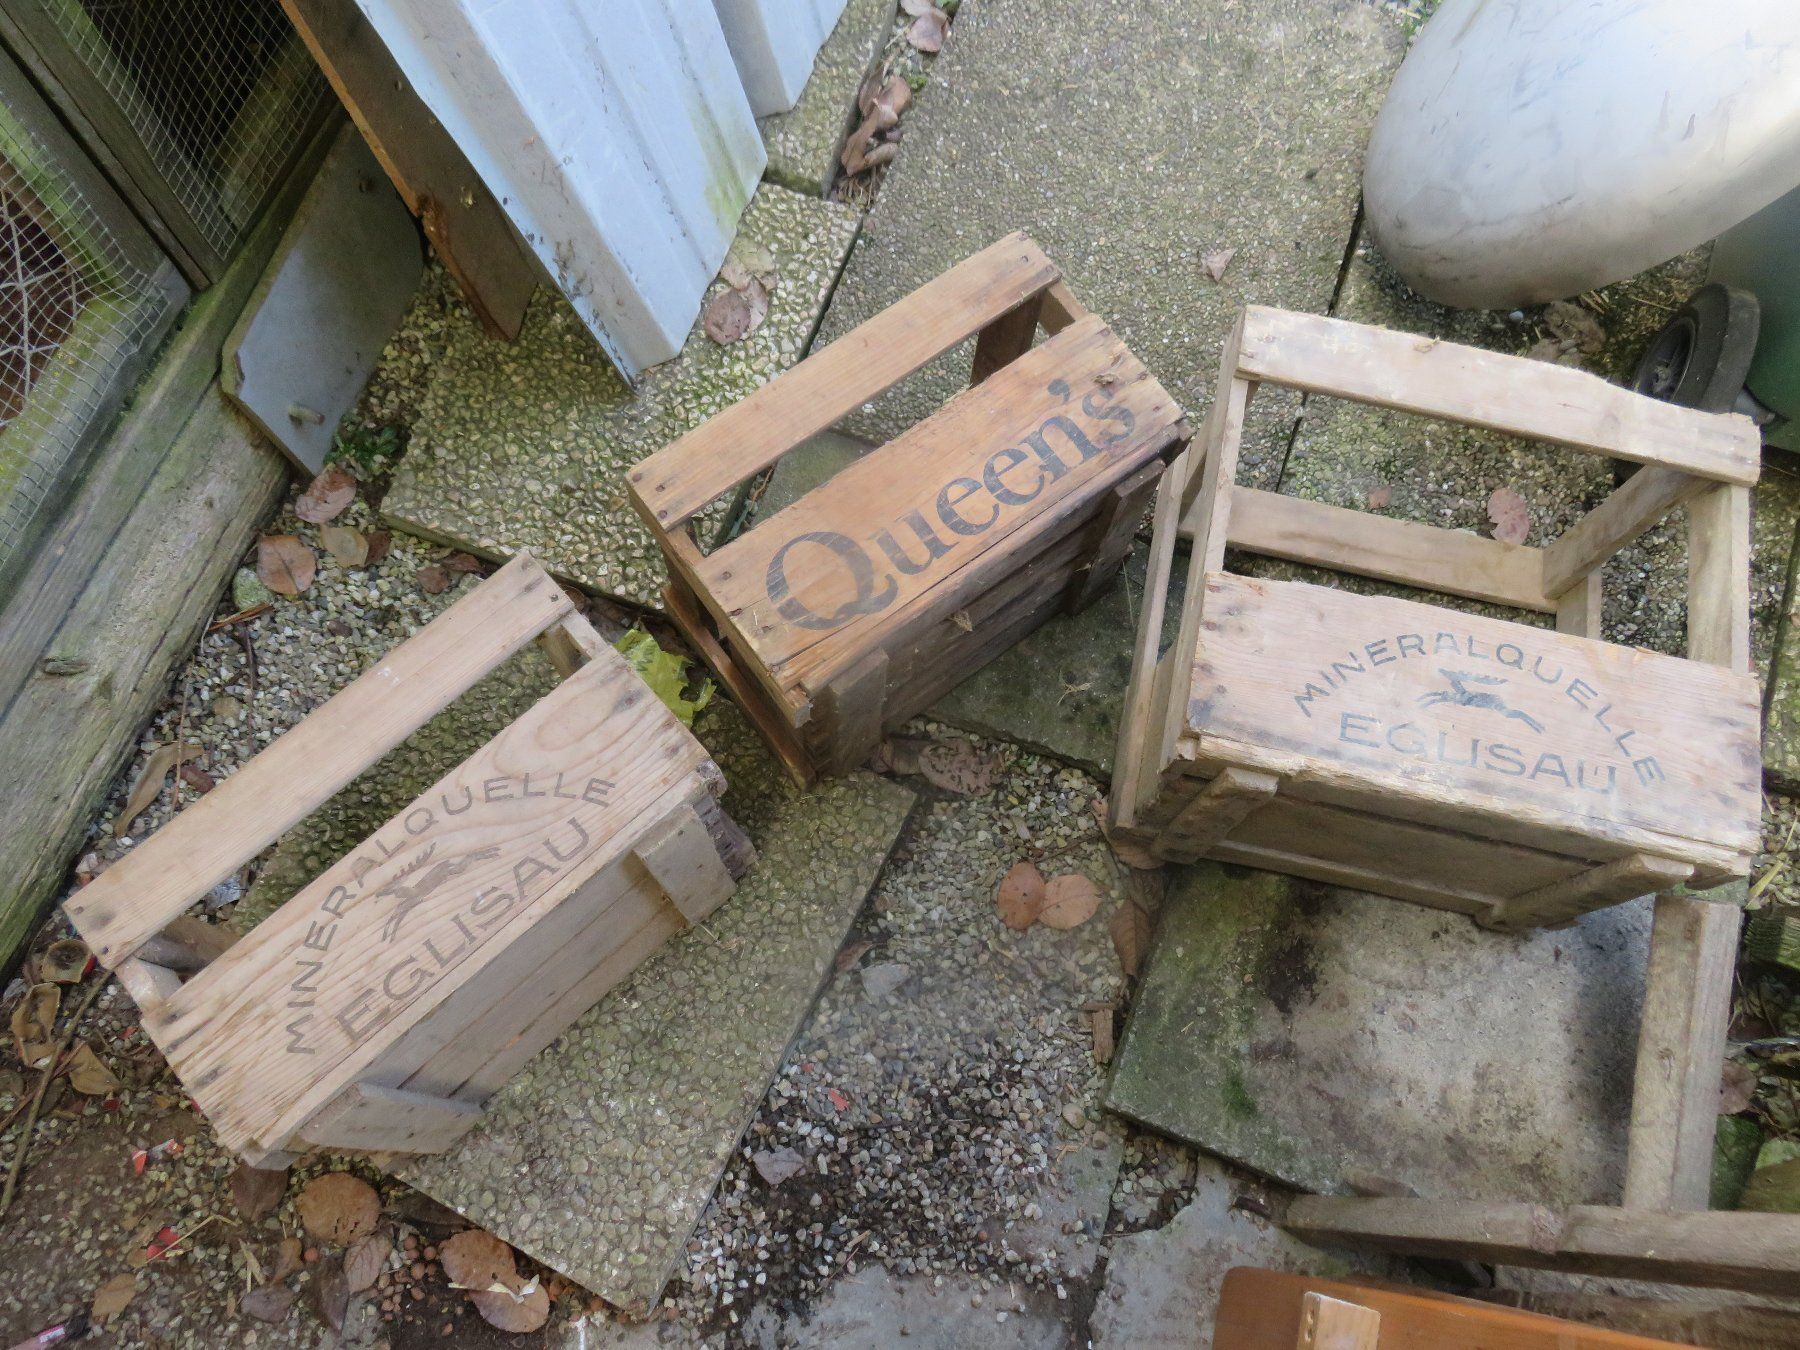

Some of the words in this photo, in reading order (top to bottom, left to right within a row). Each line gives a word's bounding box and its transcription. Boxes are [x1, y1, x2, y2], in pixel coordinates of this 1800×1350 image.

[766, 378, 1136, 631] Queen's
[1294, 632, 1666, 787] MINERALQUELLE
[1339, 712, 1617, 795] EGLISAU
[286, 773, 616, 1055] MINERALQUELLE
[336, 817, 590, 1042] EGLISAU
